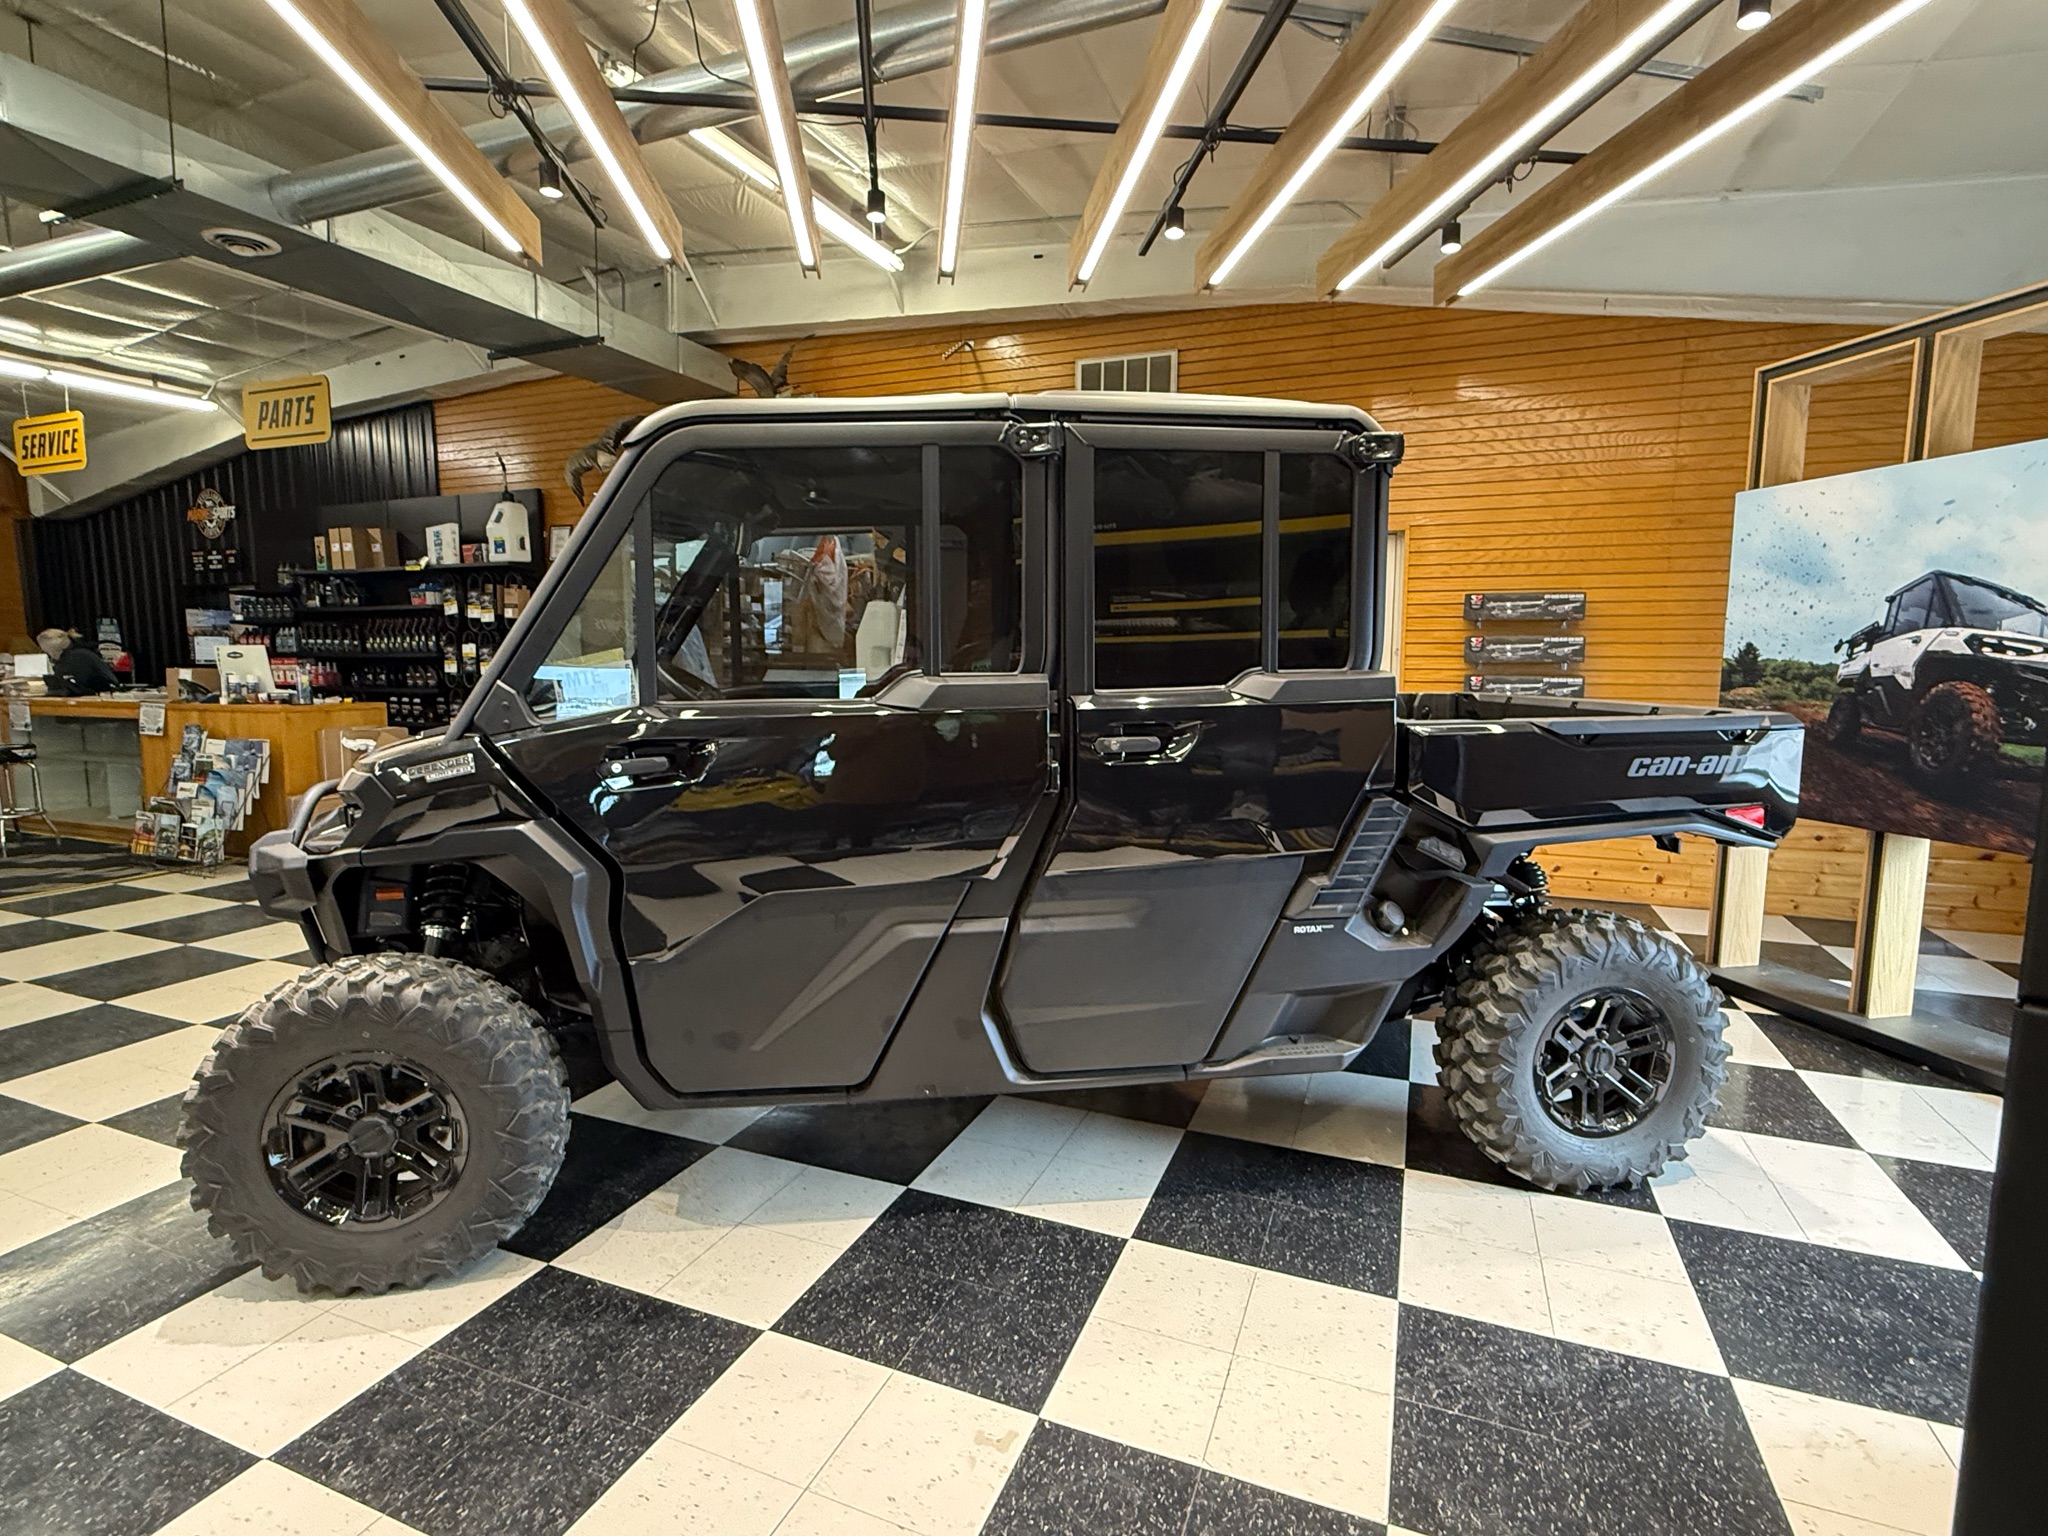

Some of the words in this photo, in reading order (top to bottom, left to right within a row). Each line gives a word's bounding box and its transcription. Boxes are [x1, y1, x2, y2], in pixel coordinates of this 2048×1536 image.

[257, 395, 315, 430] PARTS
[21, 428, 79, 460] SERVICE
[408, 756, 470, 776] DEFENDER
[1293, 924, 1322, 934] ROTAX
